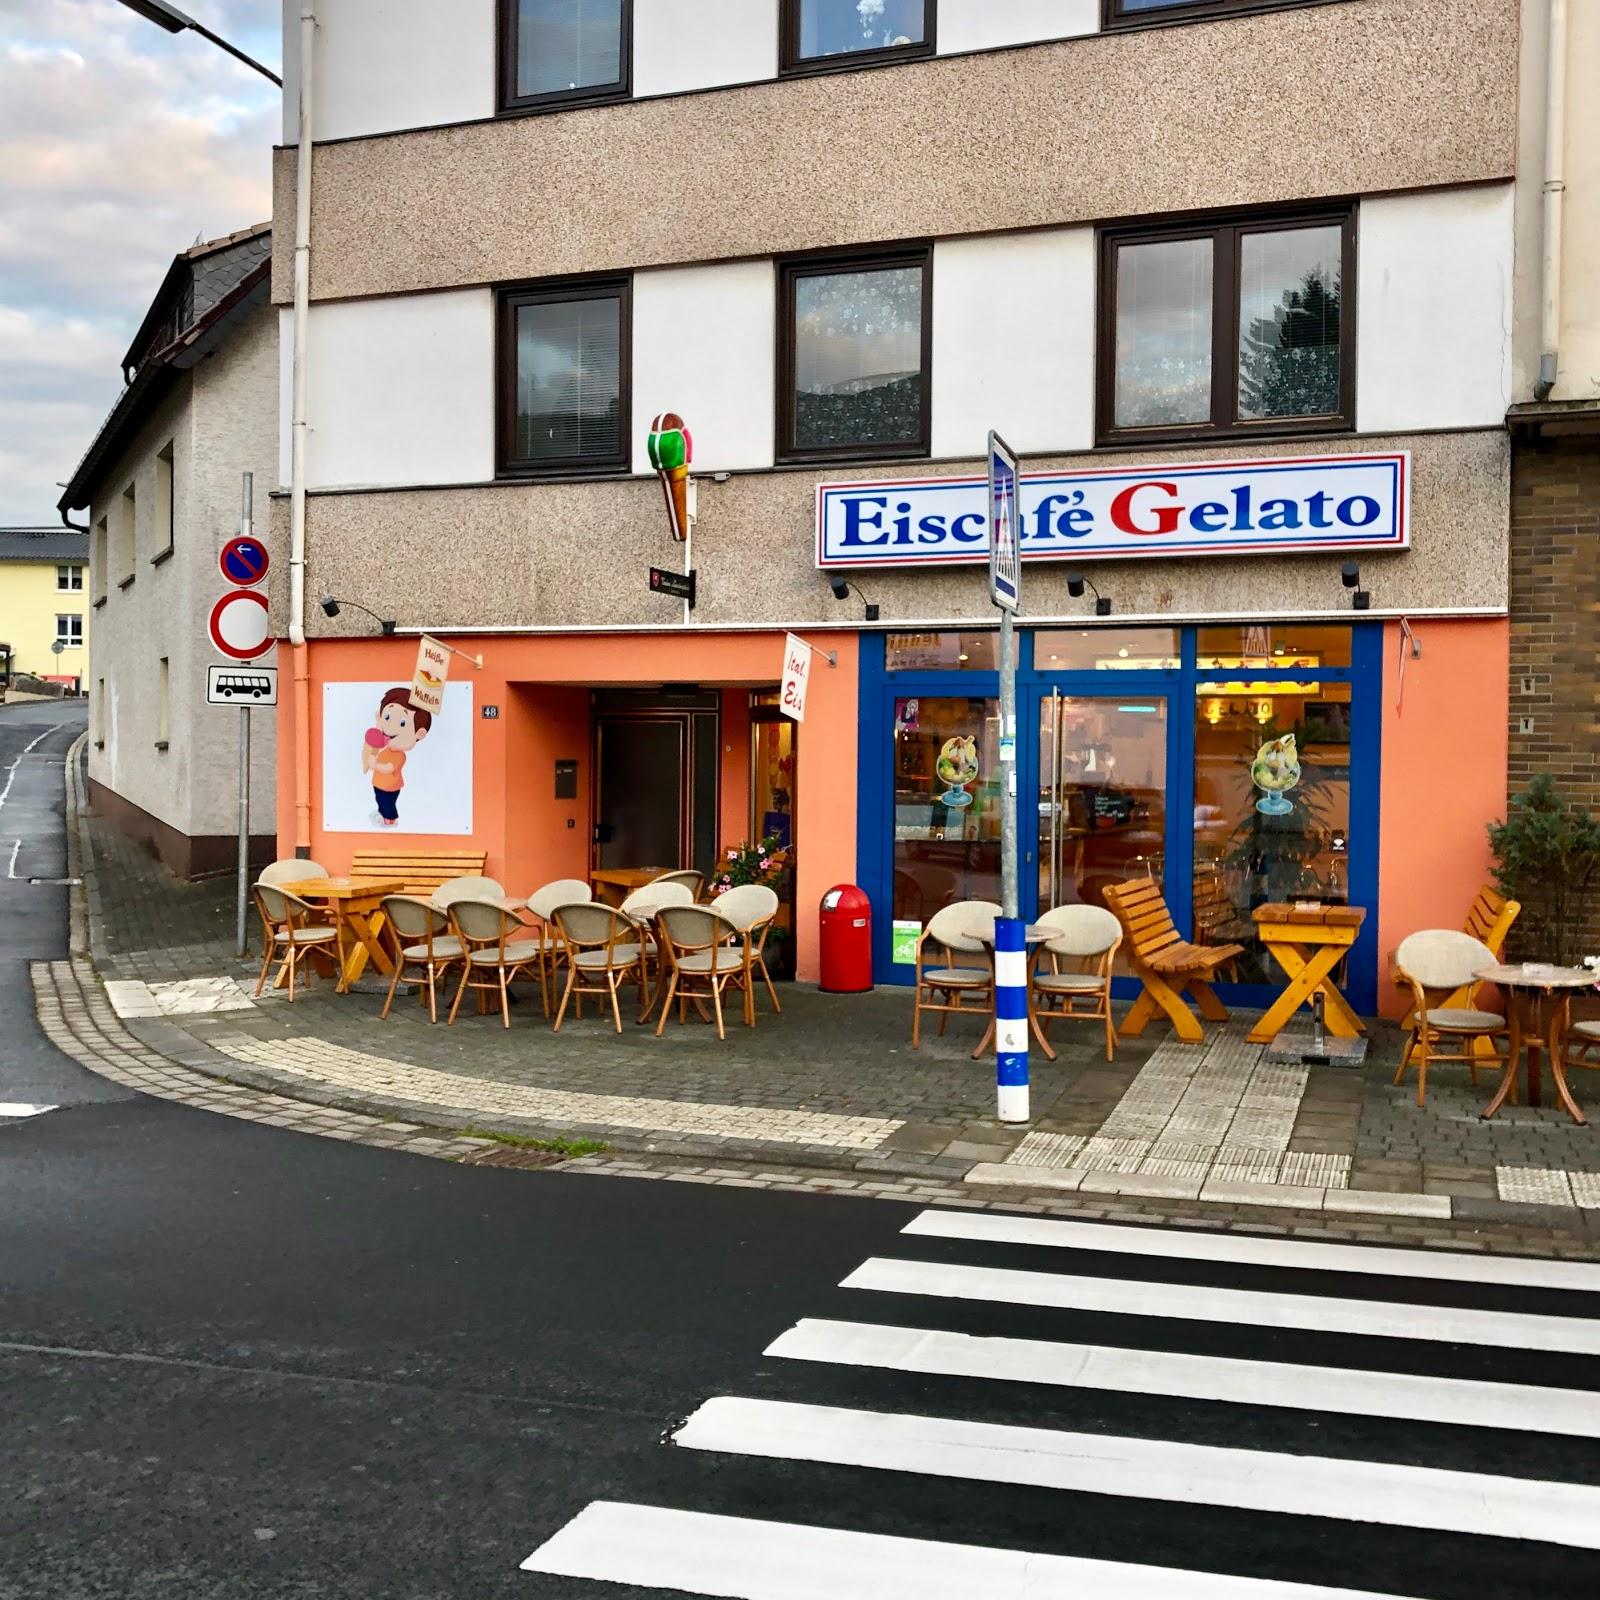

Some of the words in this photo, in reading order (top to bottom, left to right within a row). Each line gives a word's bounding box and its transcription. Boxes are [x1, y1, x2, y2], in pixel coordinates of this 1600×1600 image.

[839, 490, 1095, 546] Eiscfé
[1109, 481, 1382, 536] Gelato
[414, 686, 440, 705] Waffeln
[784, 680, 802, 711] Eis
[484, 706, 497, 717] 48
